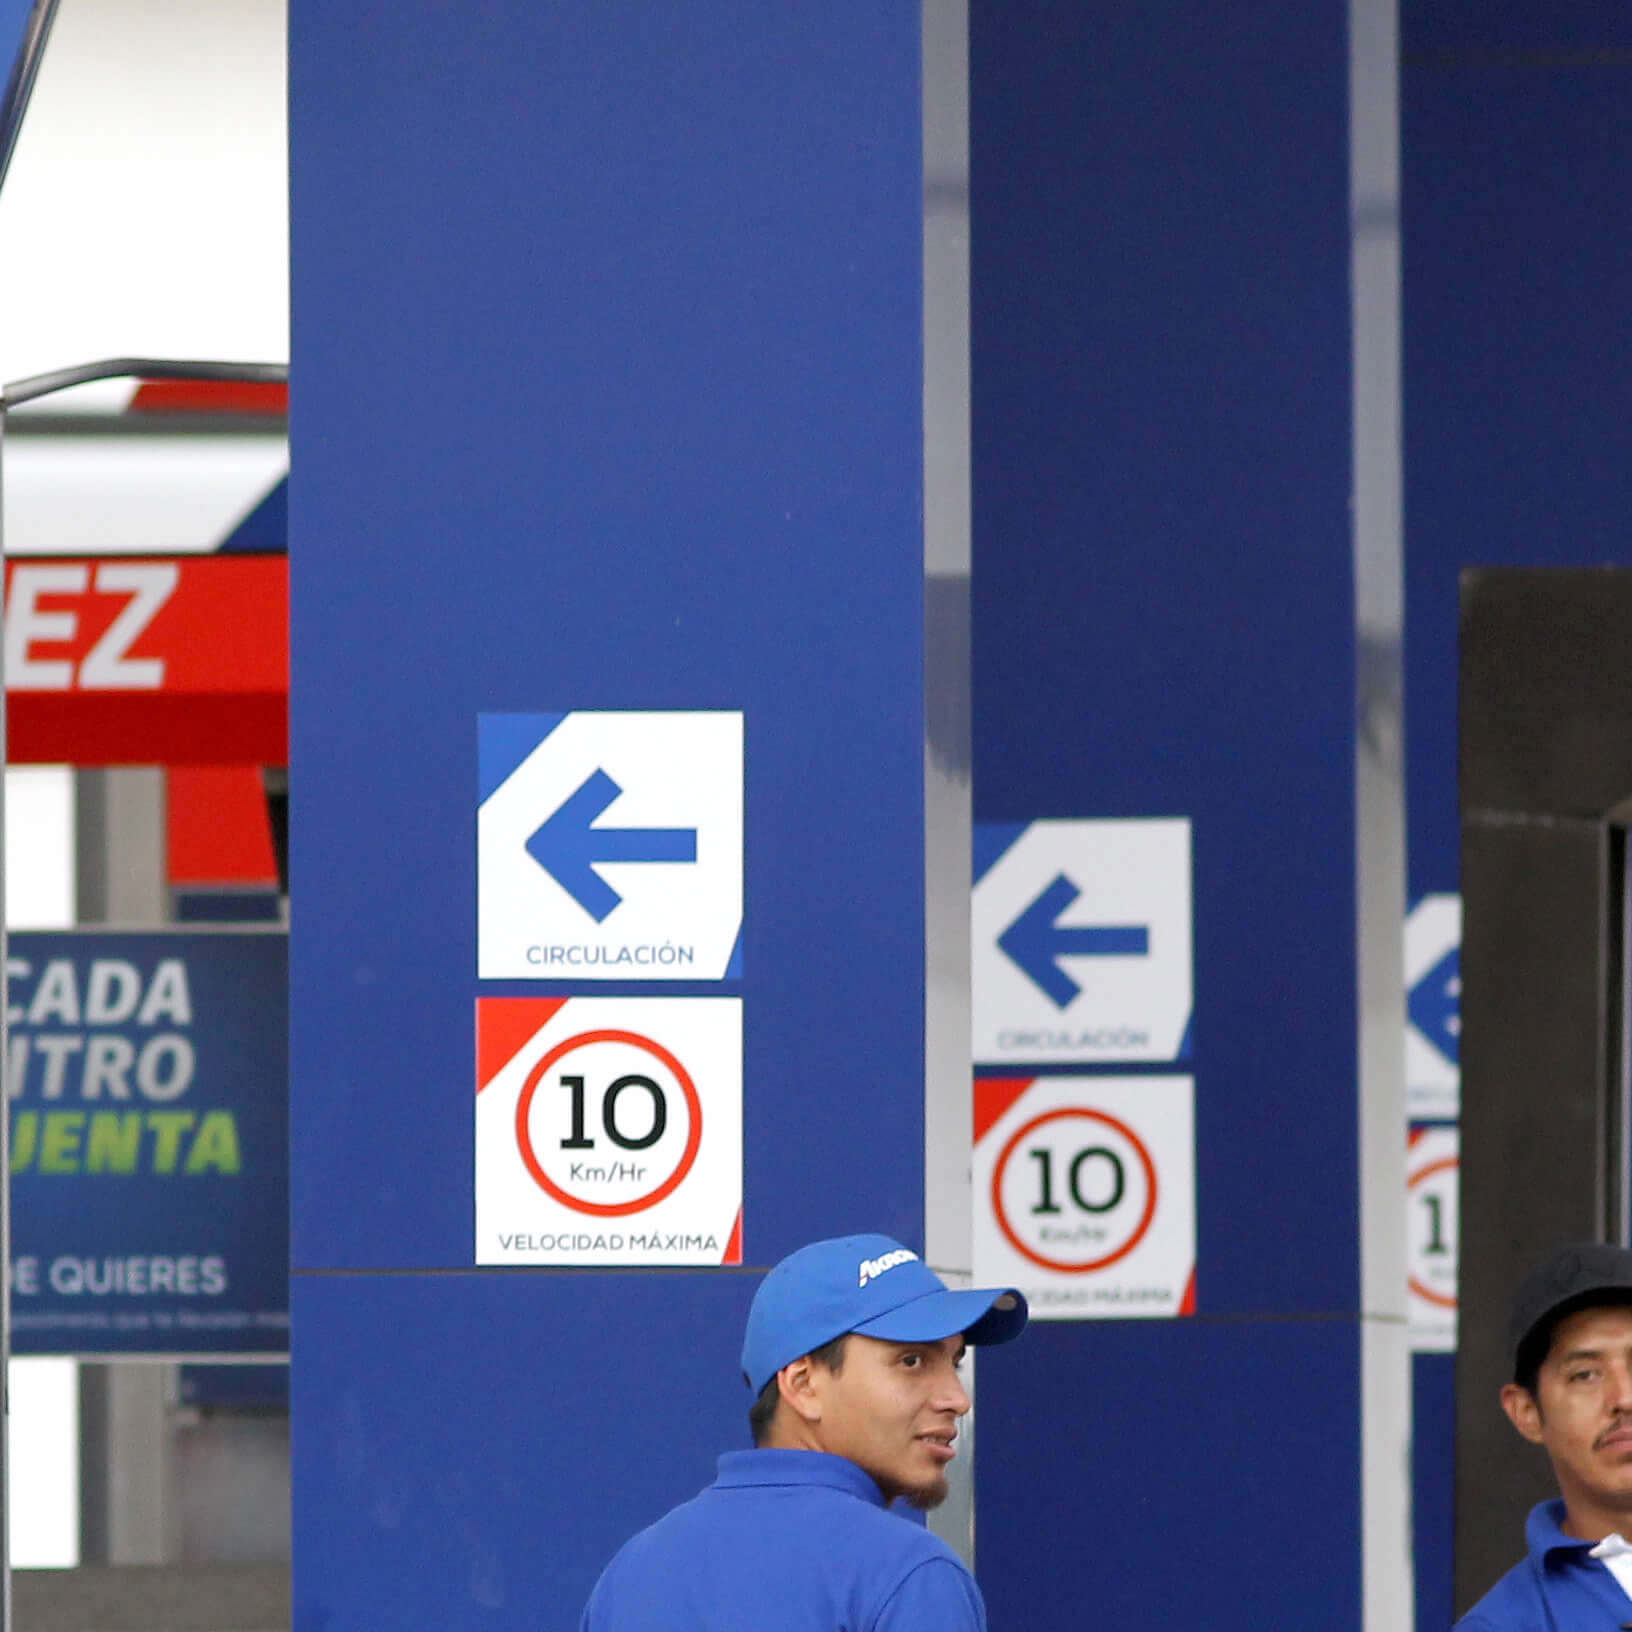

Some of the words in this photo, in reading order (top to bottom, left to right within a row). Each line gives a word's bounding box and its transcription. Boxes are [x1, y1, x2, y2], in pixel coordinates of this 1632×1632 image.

[5, 563, 180, 690] EZ
[525, 940, 695, 965] CIRCULACIÓN
[8, 1034, 196, 1101] ITRO
[558, 1074, 668, 1151] 10
[569, 1161, 646, 1184] Km/Hr
[1030, 1146, 1126, 1214] 10
[498, 1233, 624, 1252] VELOCIDAD
[628, 1230, 719, 1252] MÁXIMA
[50, 1256, 227, 1295] QUIERES
